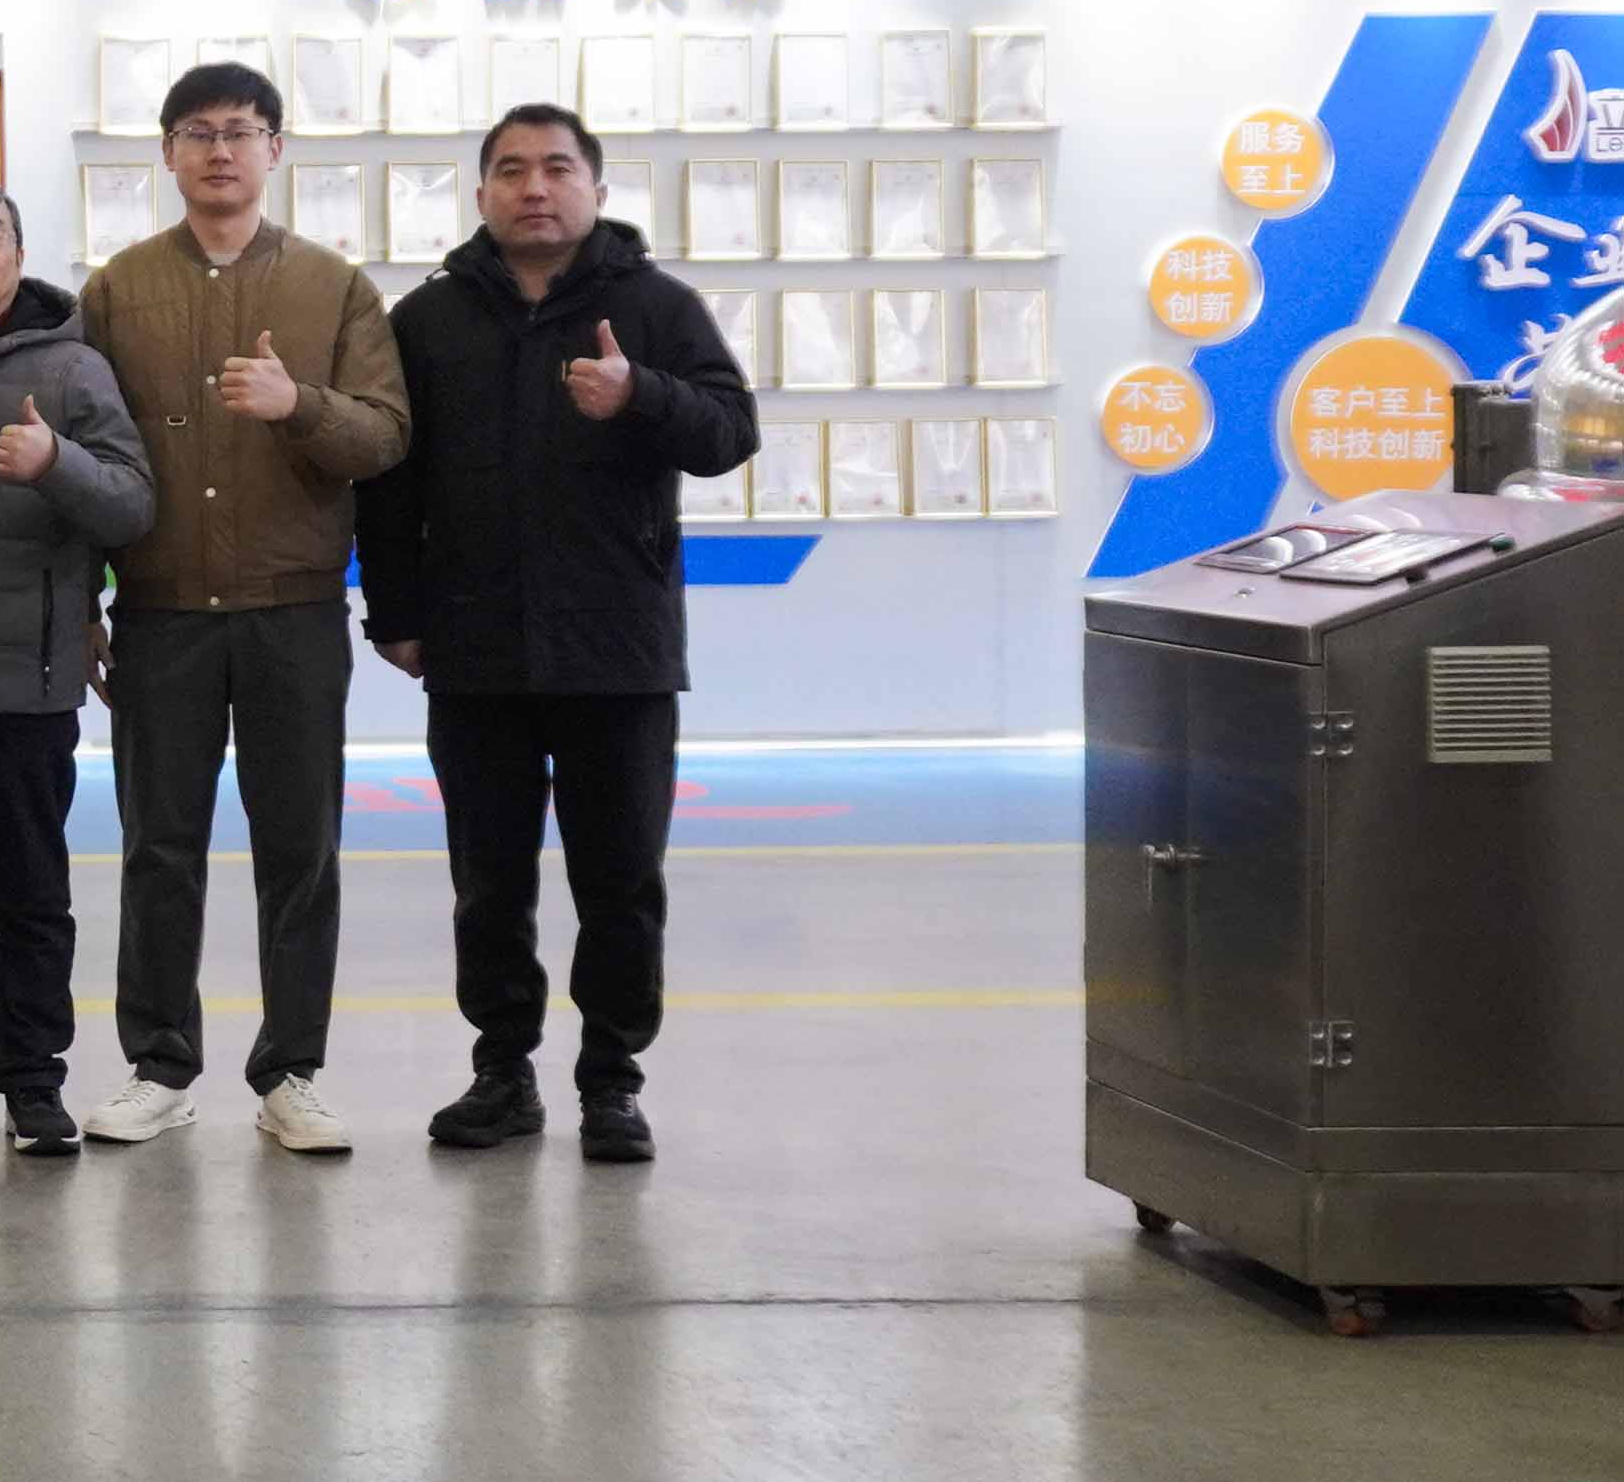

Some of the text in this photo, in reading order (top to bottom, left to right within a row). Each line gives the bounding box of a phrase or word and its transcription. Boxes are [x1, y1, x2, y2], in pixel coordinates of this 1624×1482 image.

[1239, 121, 1306, 154] 服务
[1237, 164, 1306, 194] 至上
[1166, 249, 1234, 281] 科技
[1166, 291, 1234, 323] 创新
[1118, 379, 1186, 412] 不忘
[1309, 386, 1446, 418] 客户至上
[1118, 422, 1186, 454] 初心
[1308, 427, 1446, 460] 科技创新
